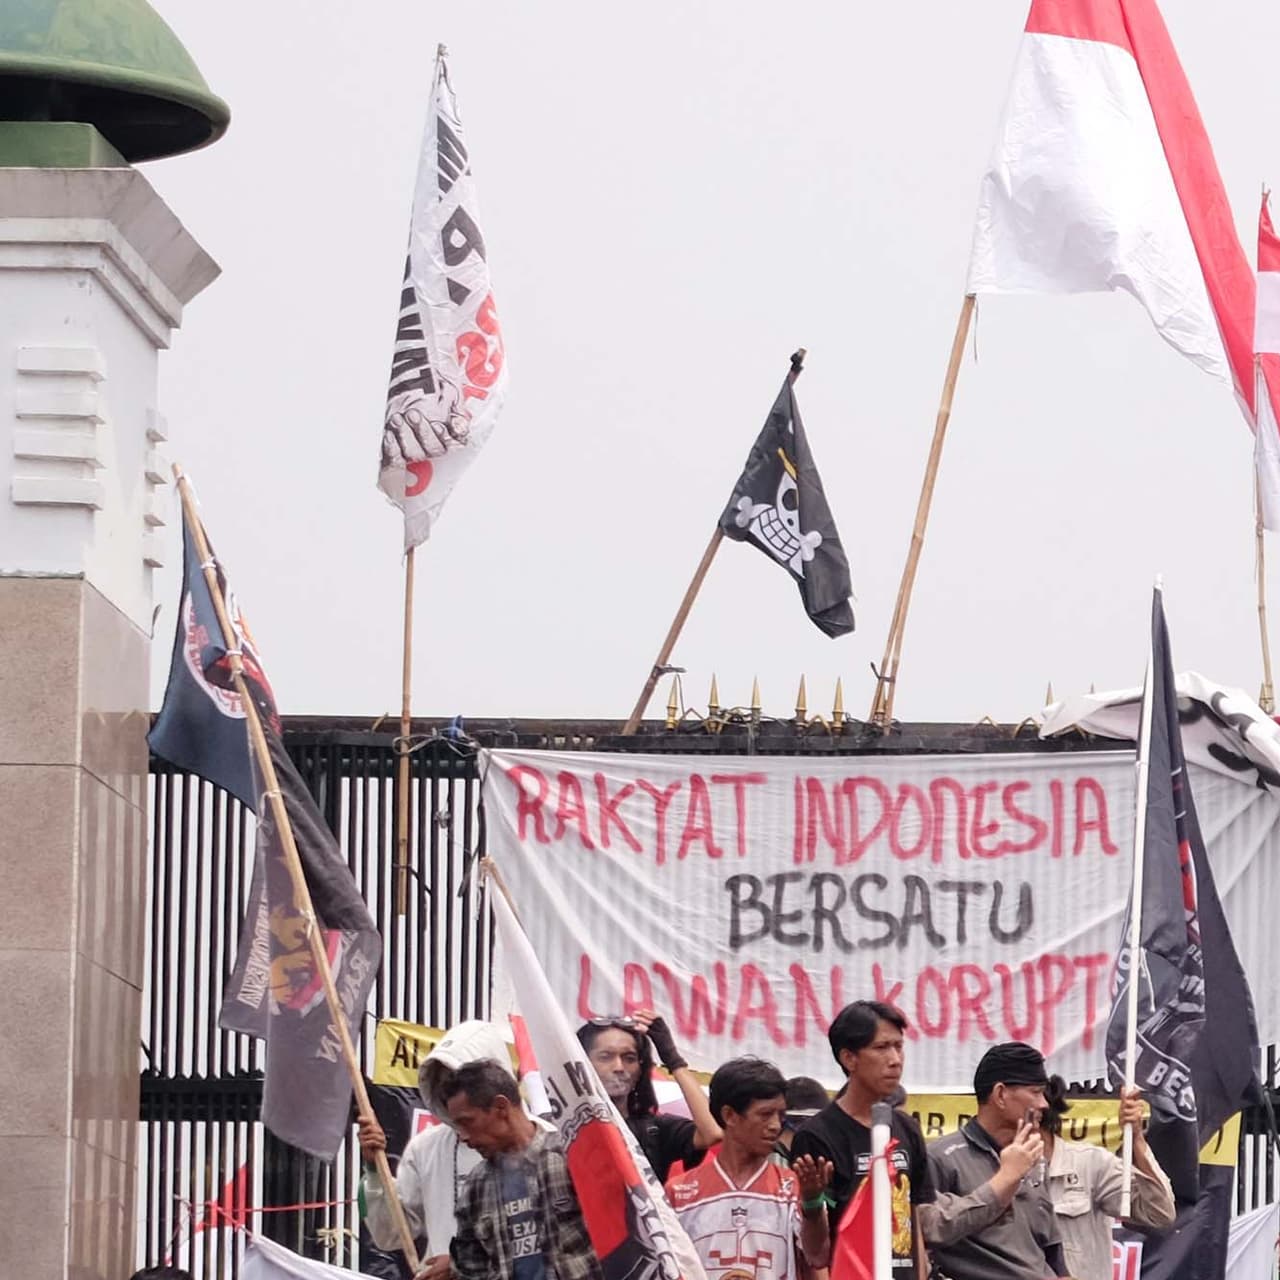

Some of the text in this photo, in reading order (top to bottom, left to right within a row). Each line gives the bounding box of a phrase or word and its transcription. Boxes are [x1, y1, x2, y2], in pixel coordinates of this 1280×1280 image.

[506, 762, 1118, 865] RAKYAT INDONESIA
[724, 871, 1036, 953] BERSATU
